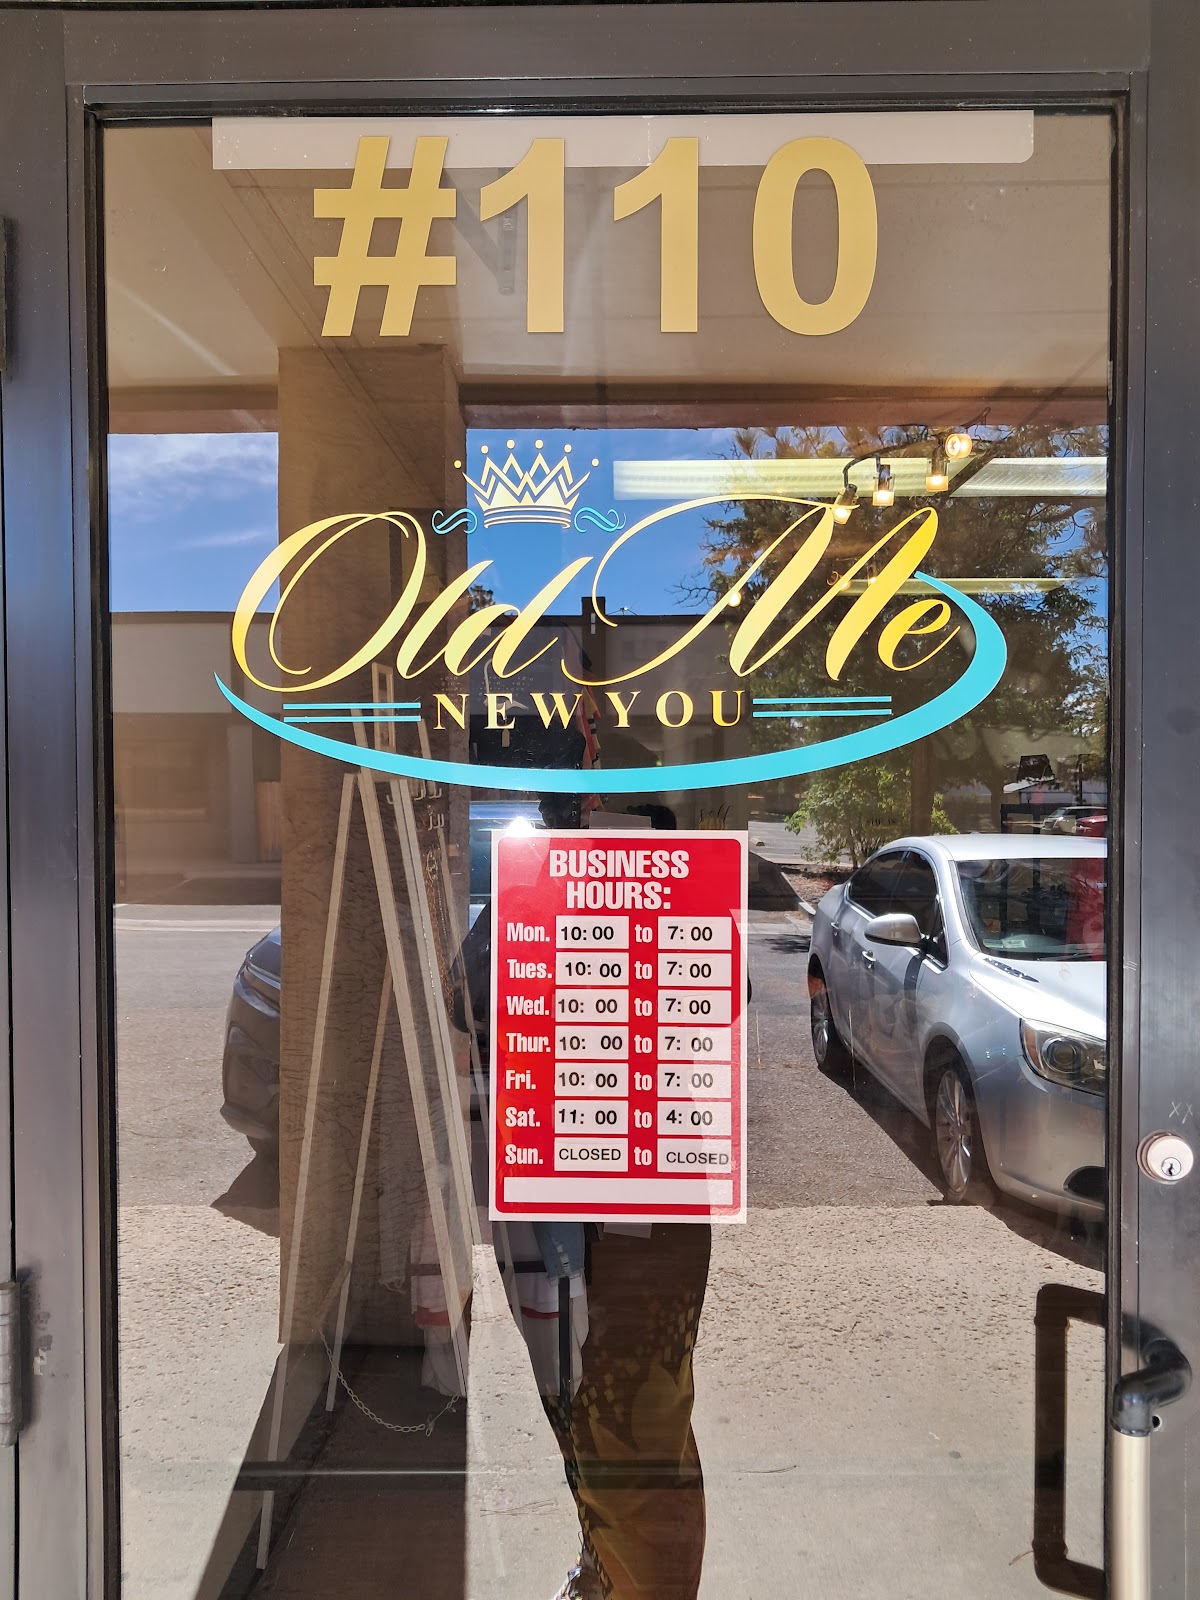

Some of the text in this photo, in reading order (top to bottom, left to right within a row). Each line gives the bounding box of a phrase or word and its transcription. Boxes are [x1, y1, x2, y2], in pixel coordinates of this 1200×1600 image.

[313, 135, 878, 337] #110
[231, 494, 962, 692] Old Me
[434, 689, 747, 731] NEW YOU
[550, 850, 689, 878] BUSINESS
[566, 881, 671, 909] HOURS:
[507, 923, 550, 942] Mon.
[635, 924, 653, 943] to
[507, 960, 552, 978] Tues.
[635, 961, 653, 979] to
[506, 996, 549, 1015] Wed.
[634, 998, 652, 1016] to
[506, 1033, 550, 1052] Thur.
[634, 1035, 652, 1053] to
[506, 1070, 536, 1089] Fri.
[634, 1072, 652, 1091] to
[505, 1107, 540, 1127] Sat.
[634, 1109, 652, 1128] to
[505, 1144, 729, 1165] Sun. CLOSED to CLOSED
